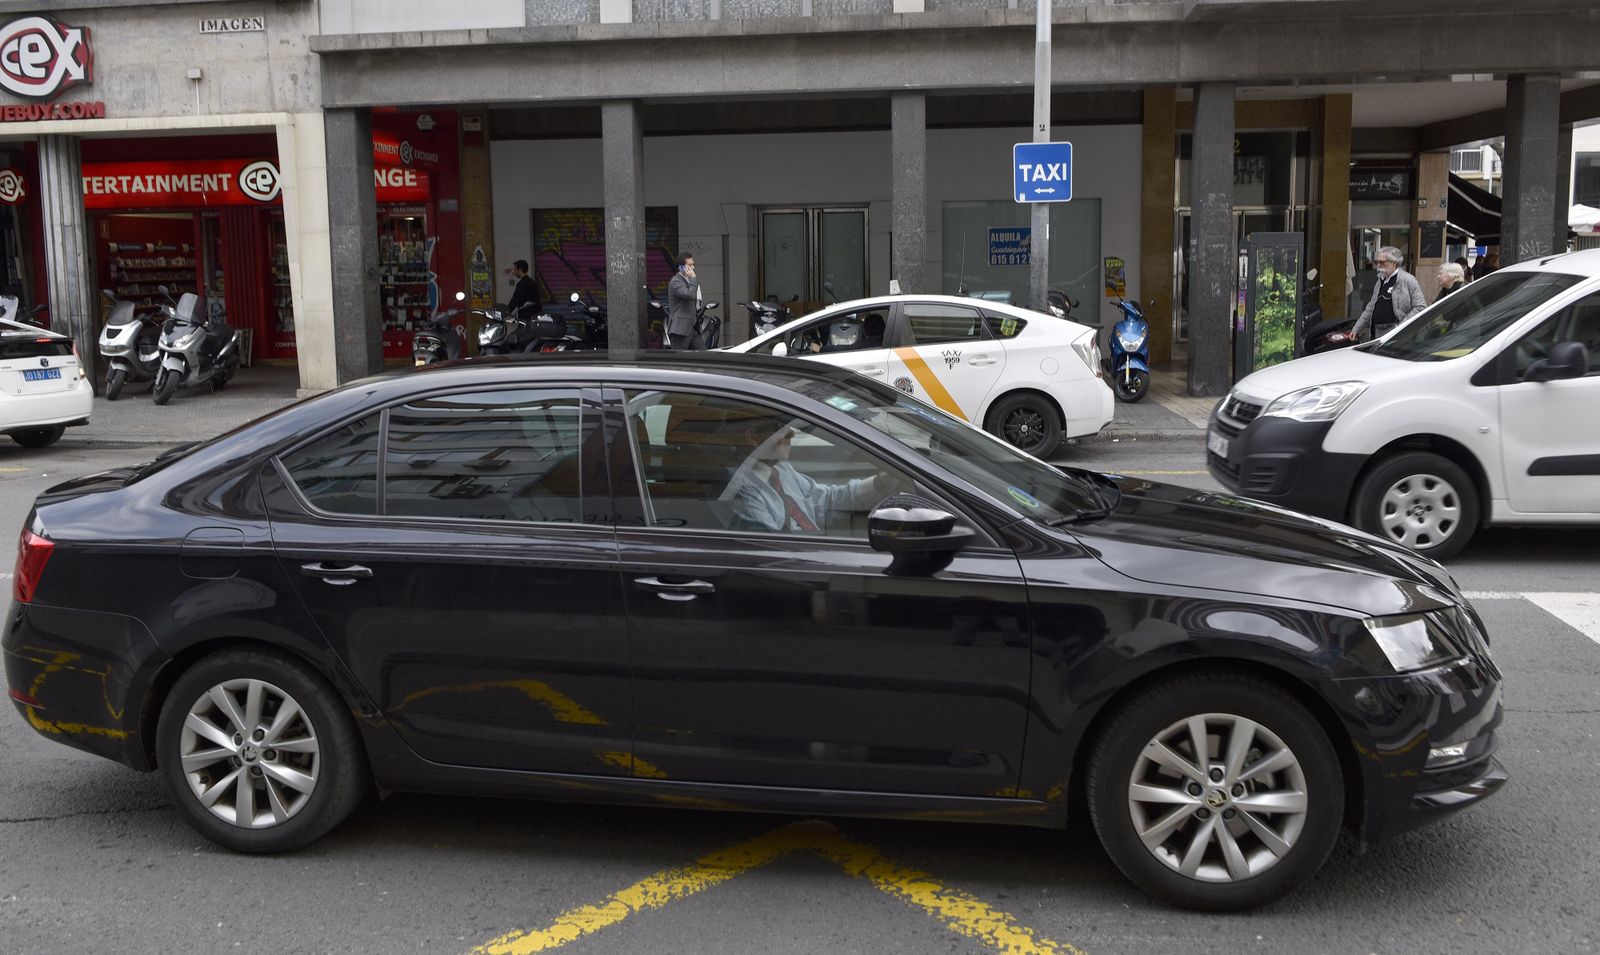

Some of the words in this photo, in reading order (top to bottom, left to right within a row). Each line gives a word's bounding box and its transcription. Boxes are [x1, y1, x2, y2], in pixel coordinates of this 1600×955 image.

[201, 18, 263, 32] IMAGEN
[1018, 163, 1067, 183] TAXI
[991, 232, 1021, 243] ALQUILA
[944, 356, 961, 364] 1959
